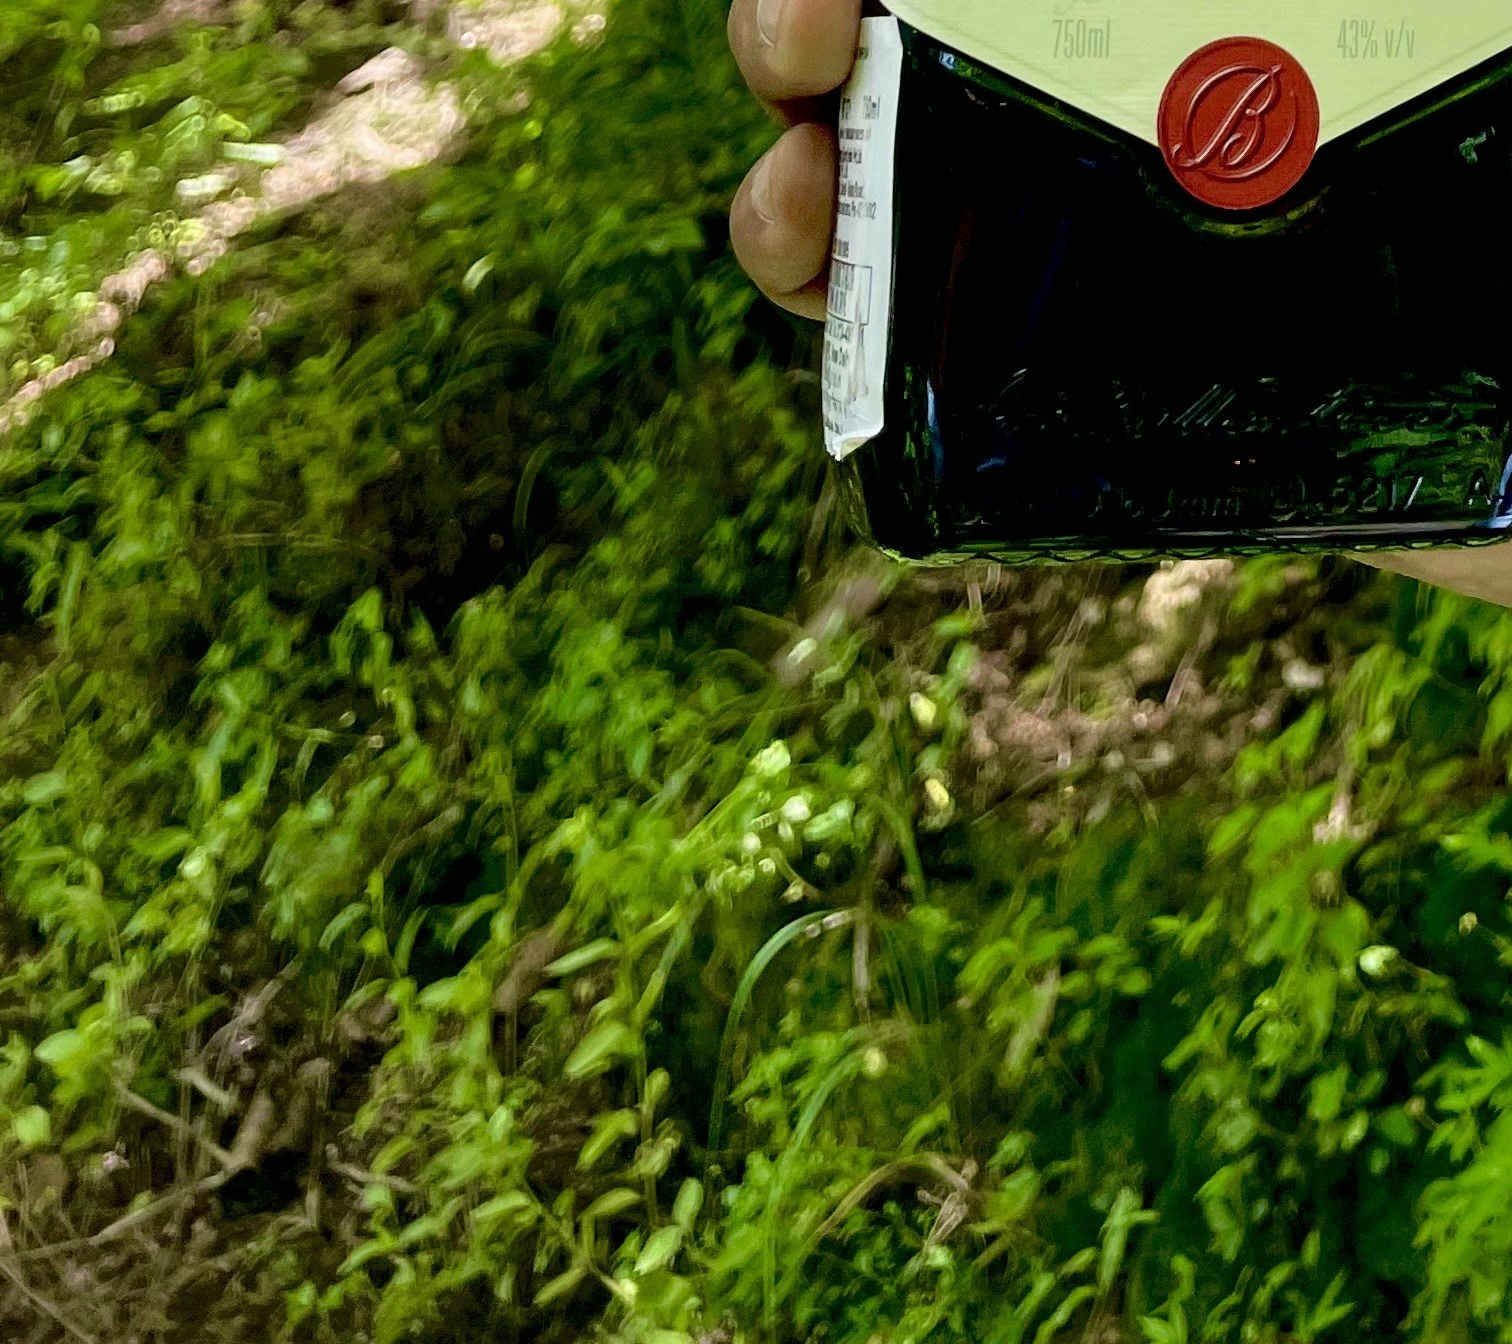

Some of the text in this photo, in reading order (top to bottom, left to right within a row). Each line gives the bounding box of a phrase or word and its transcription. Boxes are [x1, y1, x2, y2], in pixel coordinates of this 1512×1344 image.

[1052, 18, 1111, 60] 750ml
[1336, 18, 1416, 60] 43% v/v
[1171, 63, 1298, 181] B
